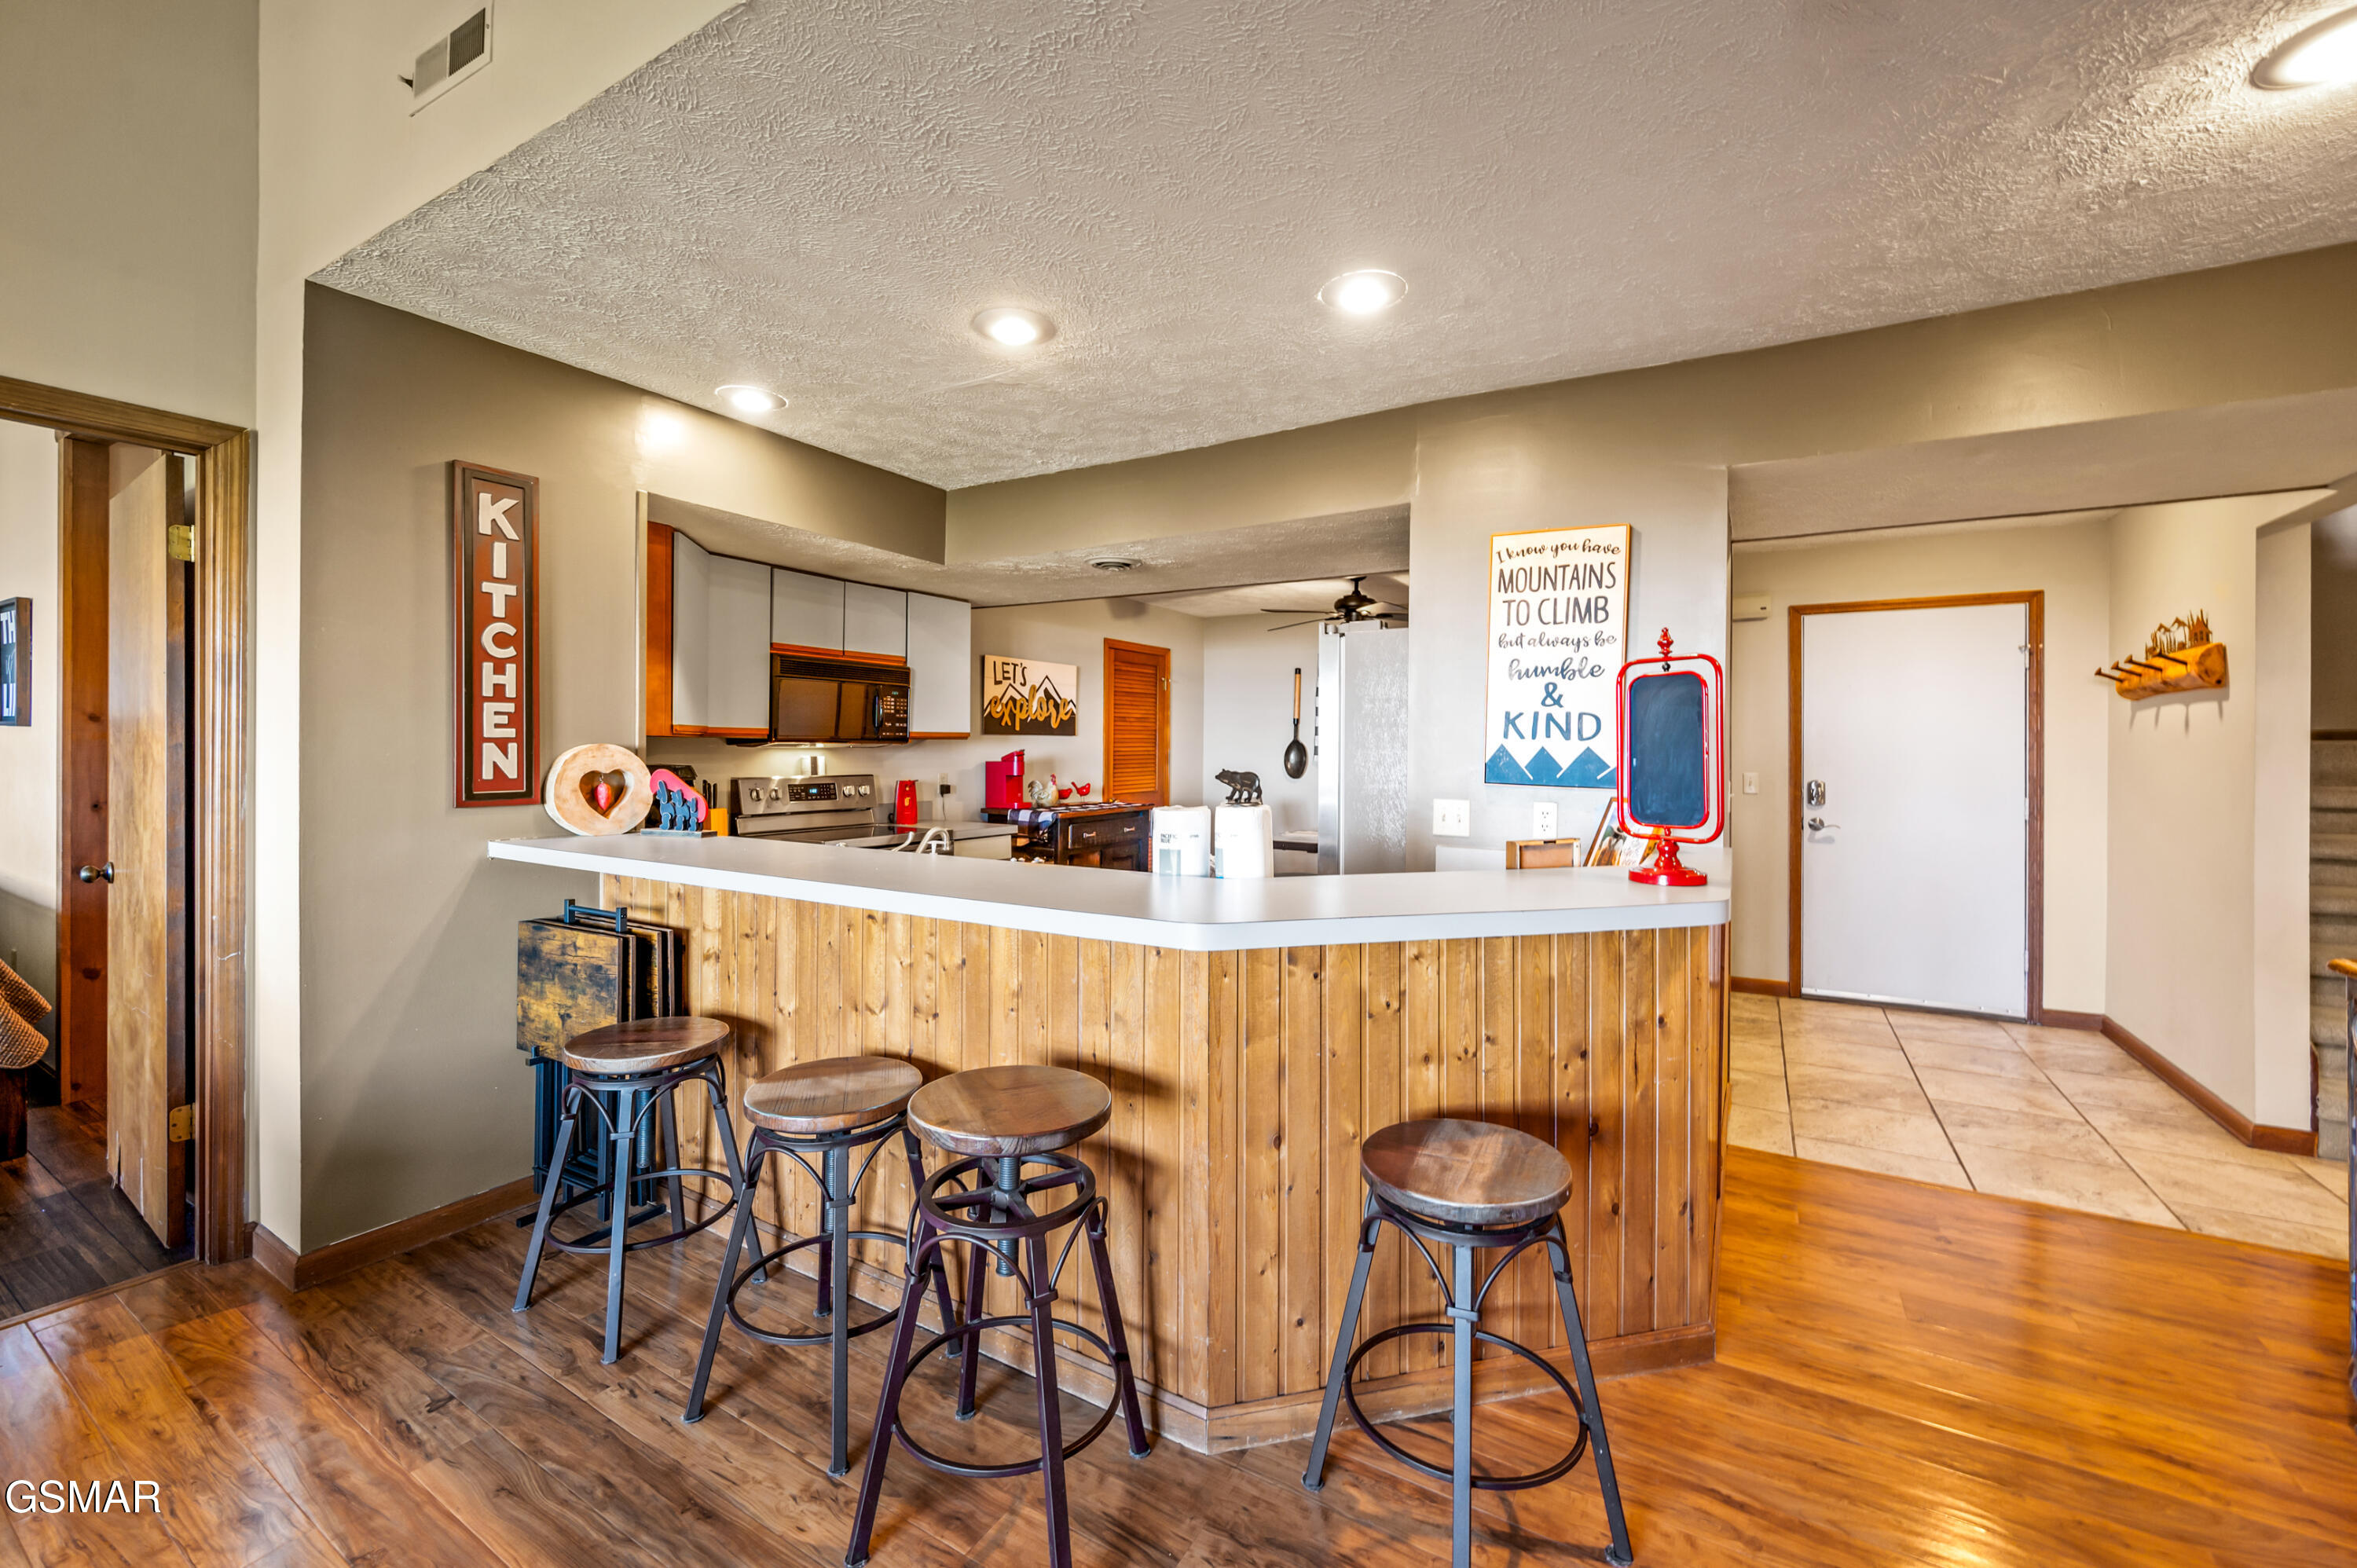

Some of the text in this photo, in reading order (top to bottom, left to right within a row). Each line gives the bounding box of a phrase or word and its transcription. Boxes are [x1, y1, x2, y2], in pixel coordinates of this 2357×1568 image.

[1496, 538, 1622, 564] I know you have
[1497, 562, 1616, 594] MOUNTAINS
[1502, 595, 1609, 626] TO CLIMB
[478, 492, 520, 780] KITCHEN
[1498, 630, 1617, 654] but always be
[993, 661, 1027, 687] LET'S
[1508, 656, 1605, 681] humble
[990, 684, 1072, 731] explore
[1541, 682, 1564, 708] &
[1503, 711, 1602, 742] KIND
